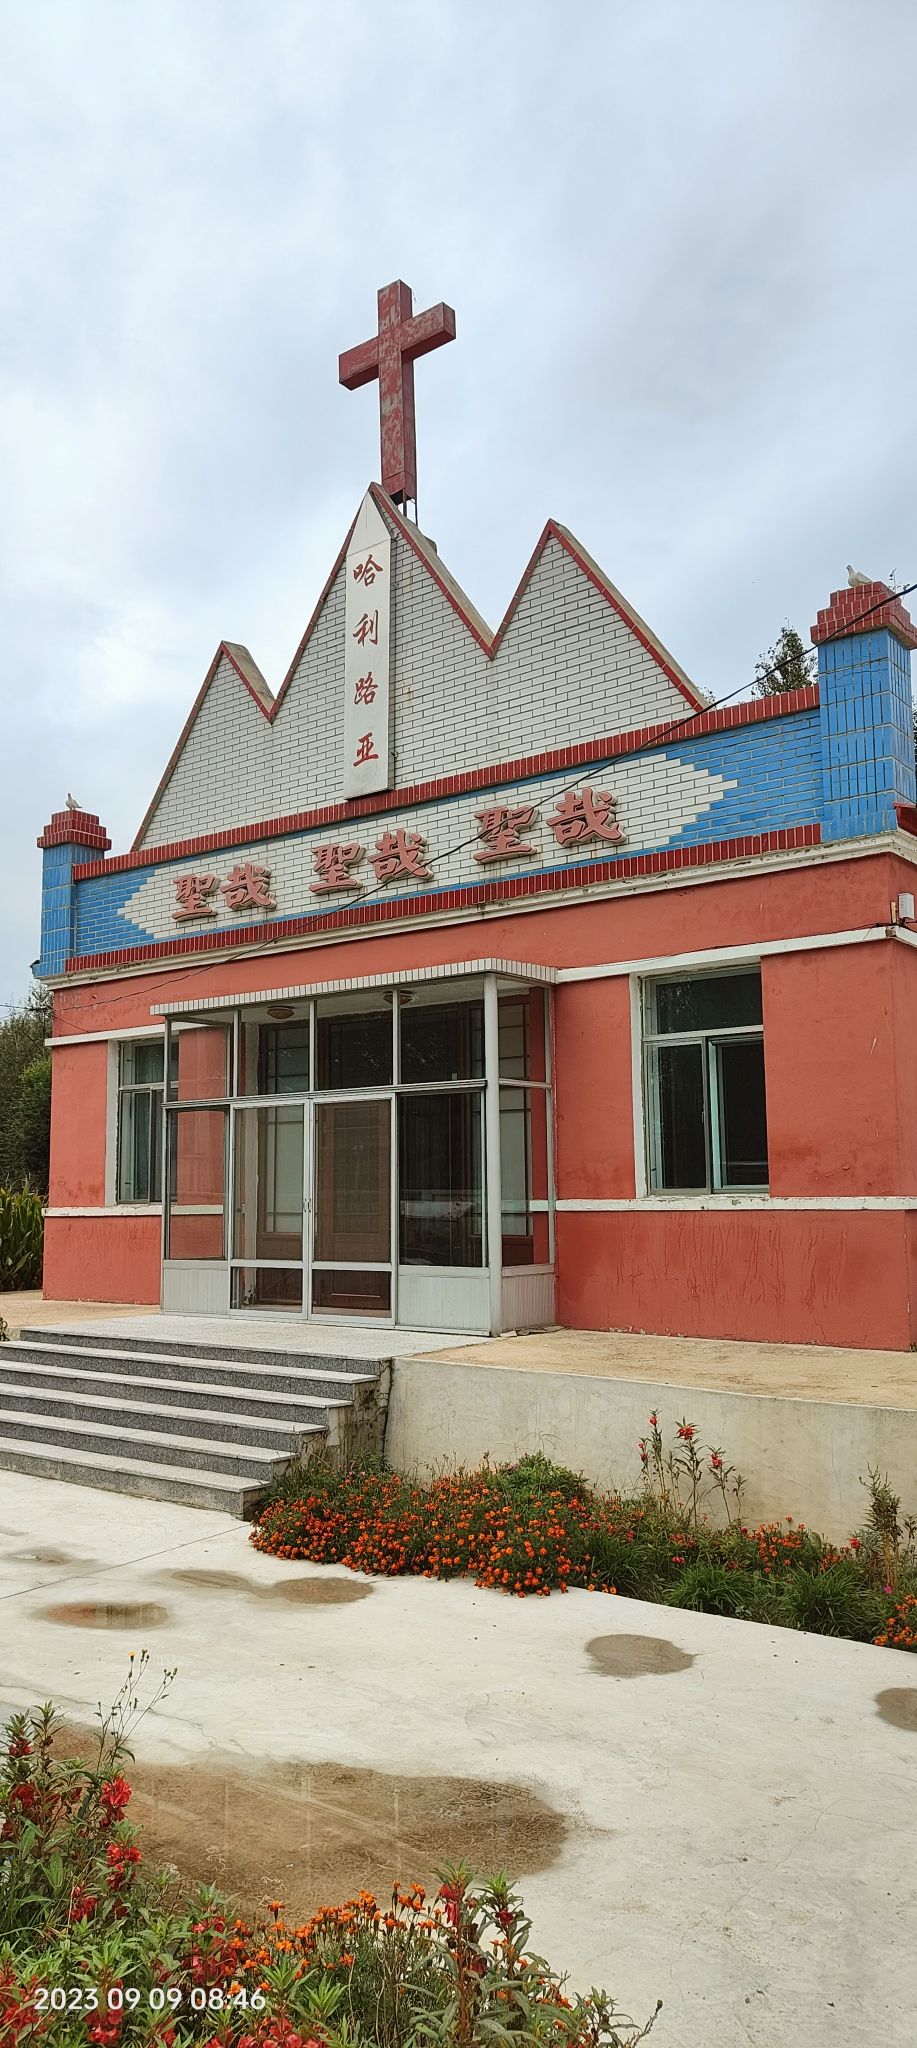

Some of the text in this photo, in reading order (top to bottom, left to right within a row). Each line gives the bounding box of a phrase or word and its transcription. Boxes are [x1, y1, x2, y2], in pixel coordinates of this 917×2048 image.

[351, 553, 384, 768] 哈利路亚
[171, 786, 628, 922] 聖哉 聖哉 聖哉
